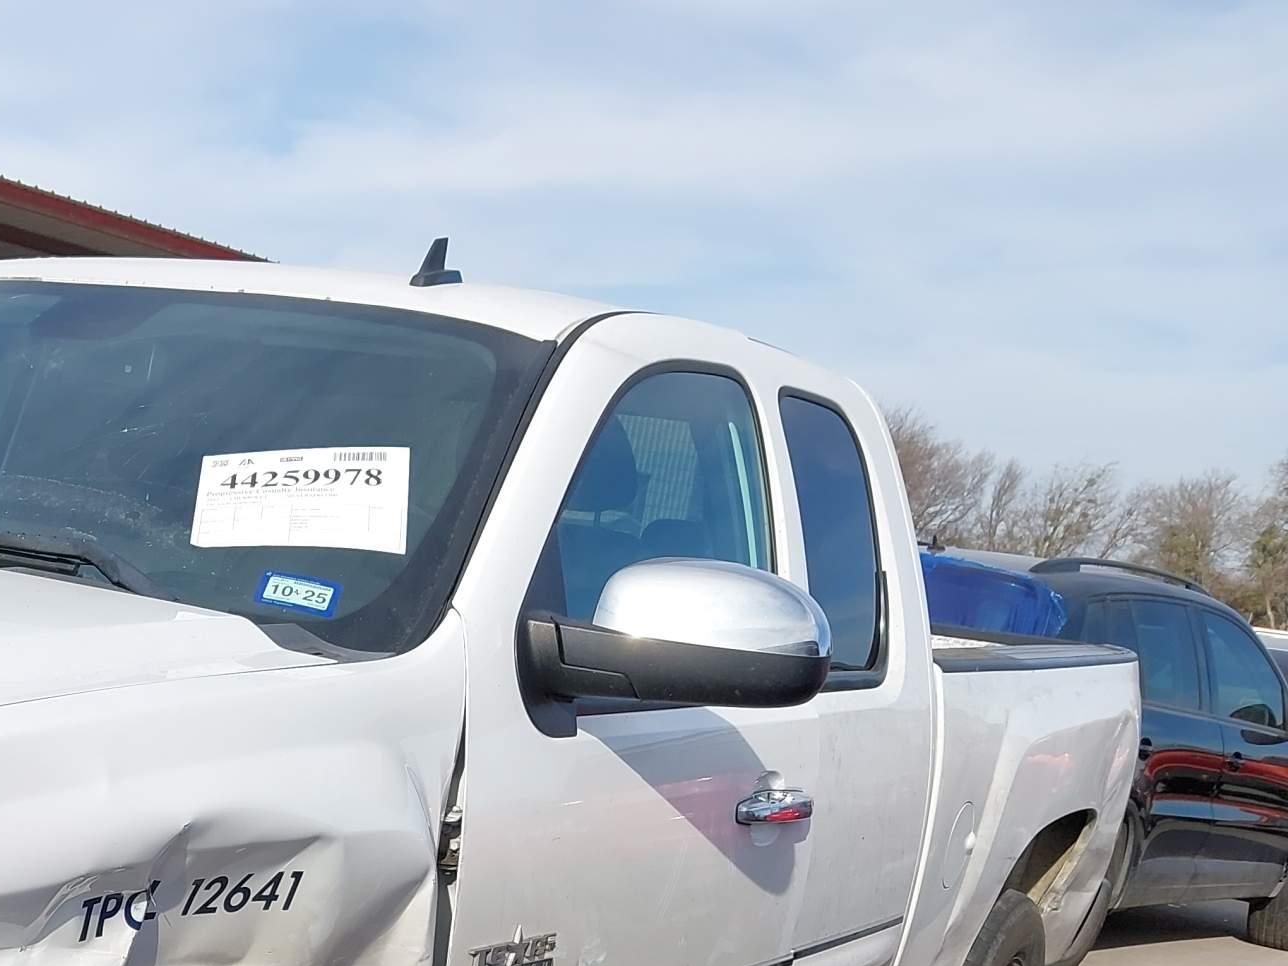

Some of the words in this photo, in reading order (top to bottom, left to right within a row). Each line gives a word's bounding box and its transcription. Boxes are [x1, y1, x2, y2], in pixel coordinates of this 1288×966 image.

[220, 468, 383, 489] 44259978
[272, 584, 294, 597] 10
[302, 590, 329, 604] 25
[180, 870, 305, 917] 12641
